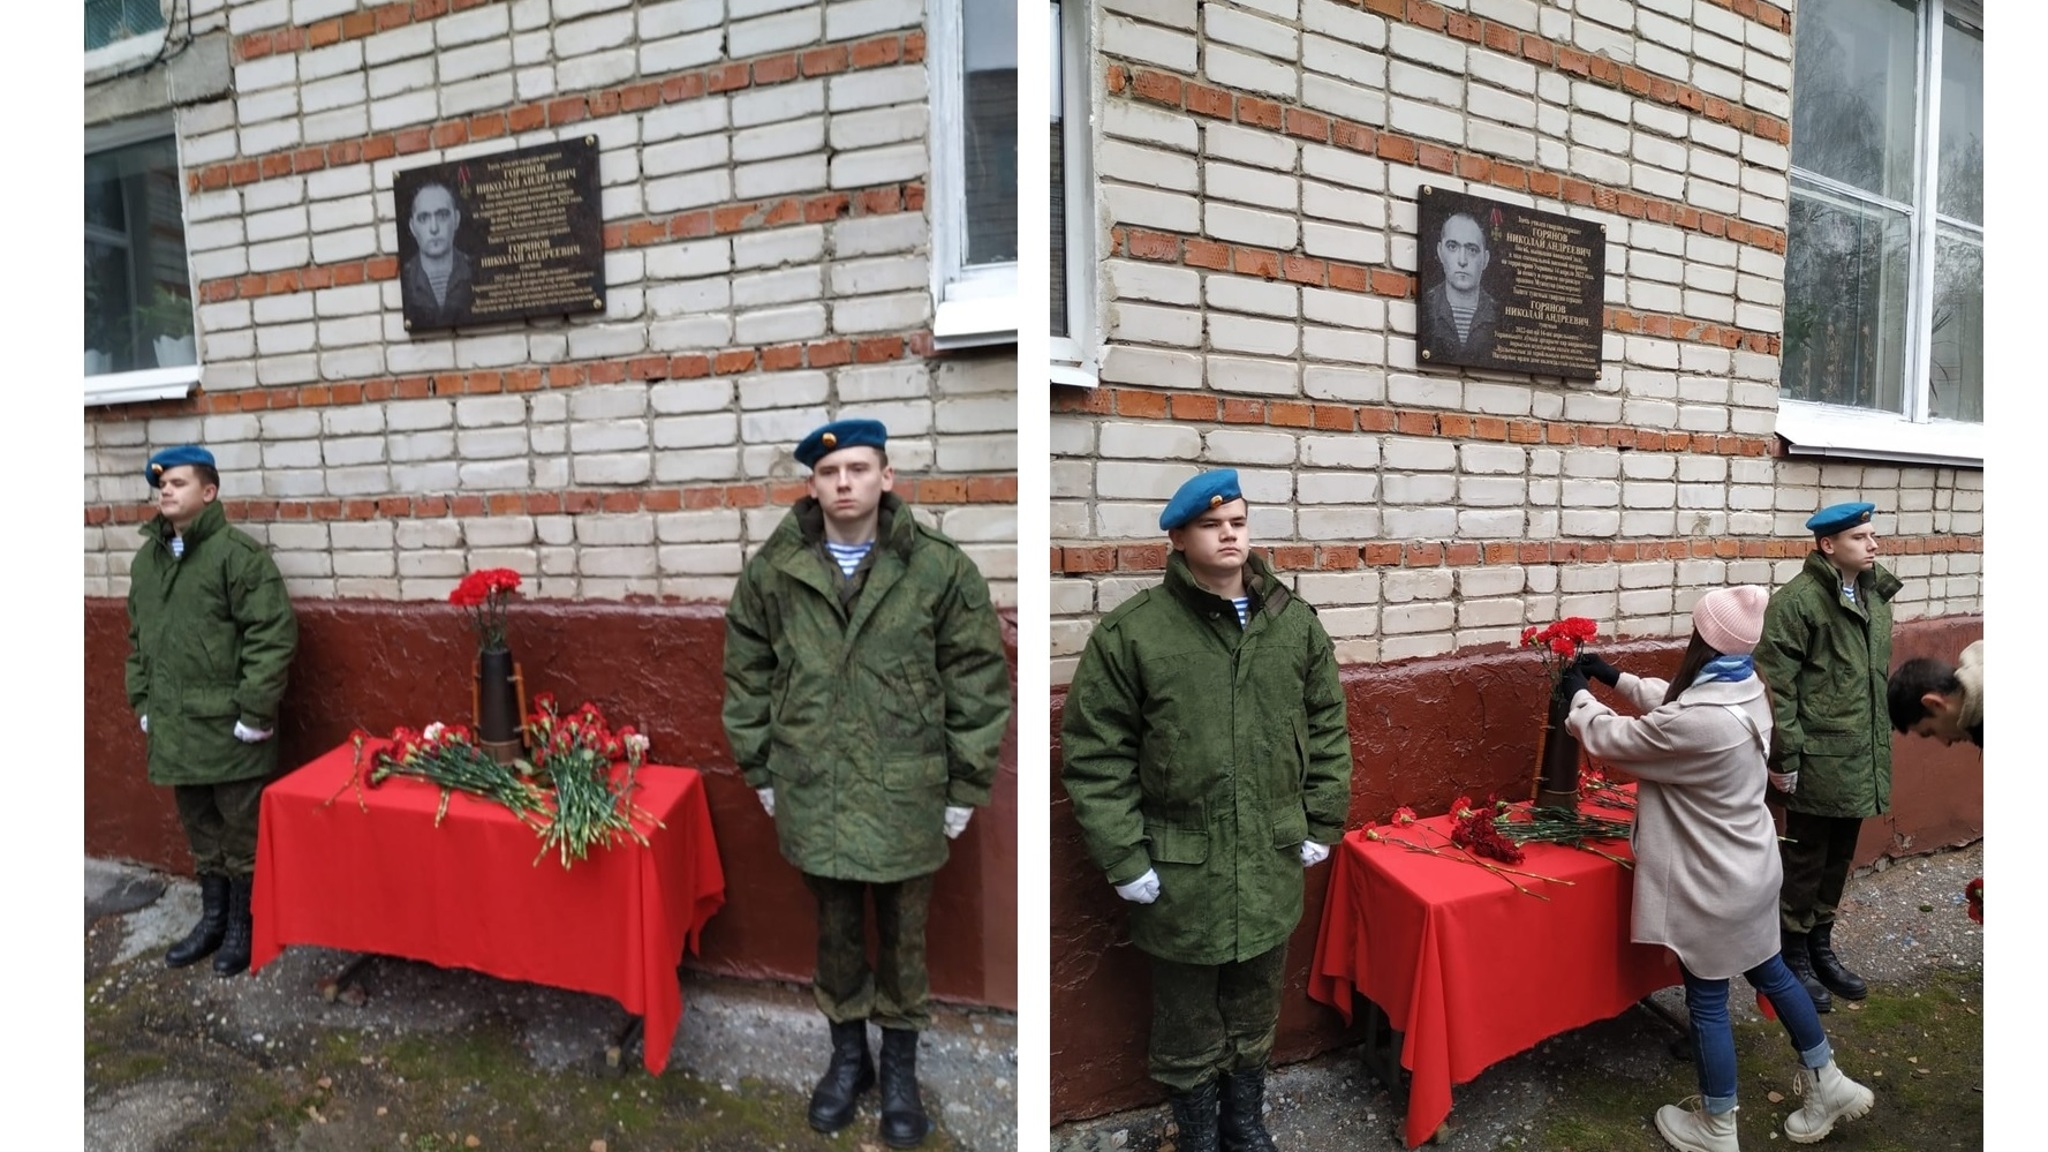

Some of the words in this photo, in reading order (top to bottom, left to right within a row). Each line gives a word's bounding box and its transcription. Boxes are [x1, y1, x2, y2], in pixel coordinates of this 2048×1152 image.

[503, 162, 545, 179] ГОРЯНОВ
[475, 177, 519, 195] НИКОЛАЙ
[521, 168, 576, 187] АНДРЕЕВИЧ
[1506, 231, 1545, 248] НИКОЛАЙ
[1545, 239, 1591, 258] АНДРЕЕВИЧ
[1532, 227, 1568, 243] ГОРЯНОВ
[508, 238, 550, 254] ГОРЯНОВ
[480, 252, 524, 268] НИКОЛАЙ
[527, 244, 580, 261] АНДРЕЕВИЧ
[1505, 305, 1543, 319] НИКОЛАЙ
[1543, 312, 1588, 326] АНДРЕЕВИЧ
[1530, 300, 1565, 315] ГОРЯНОВ
